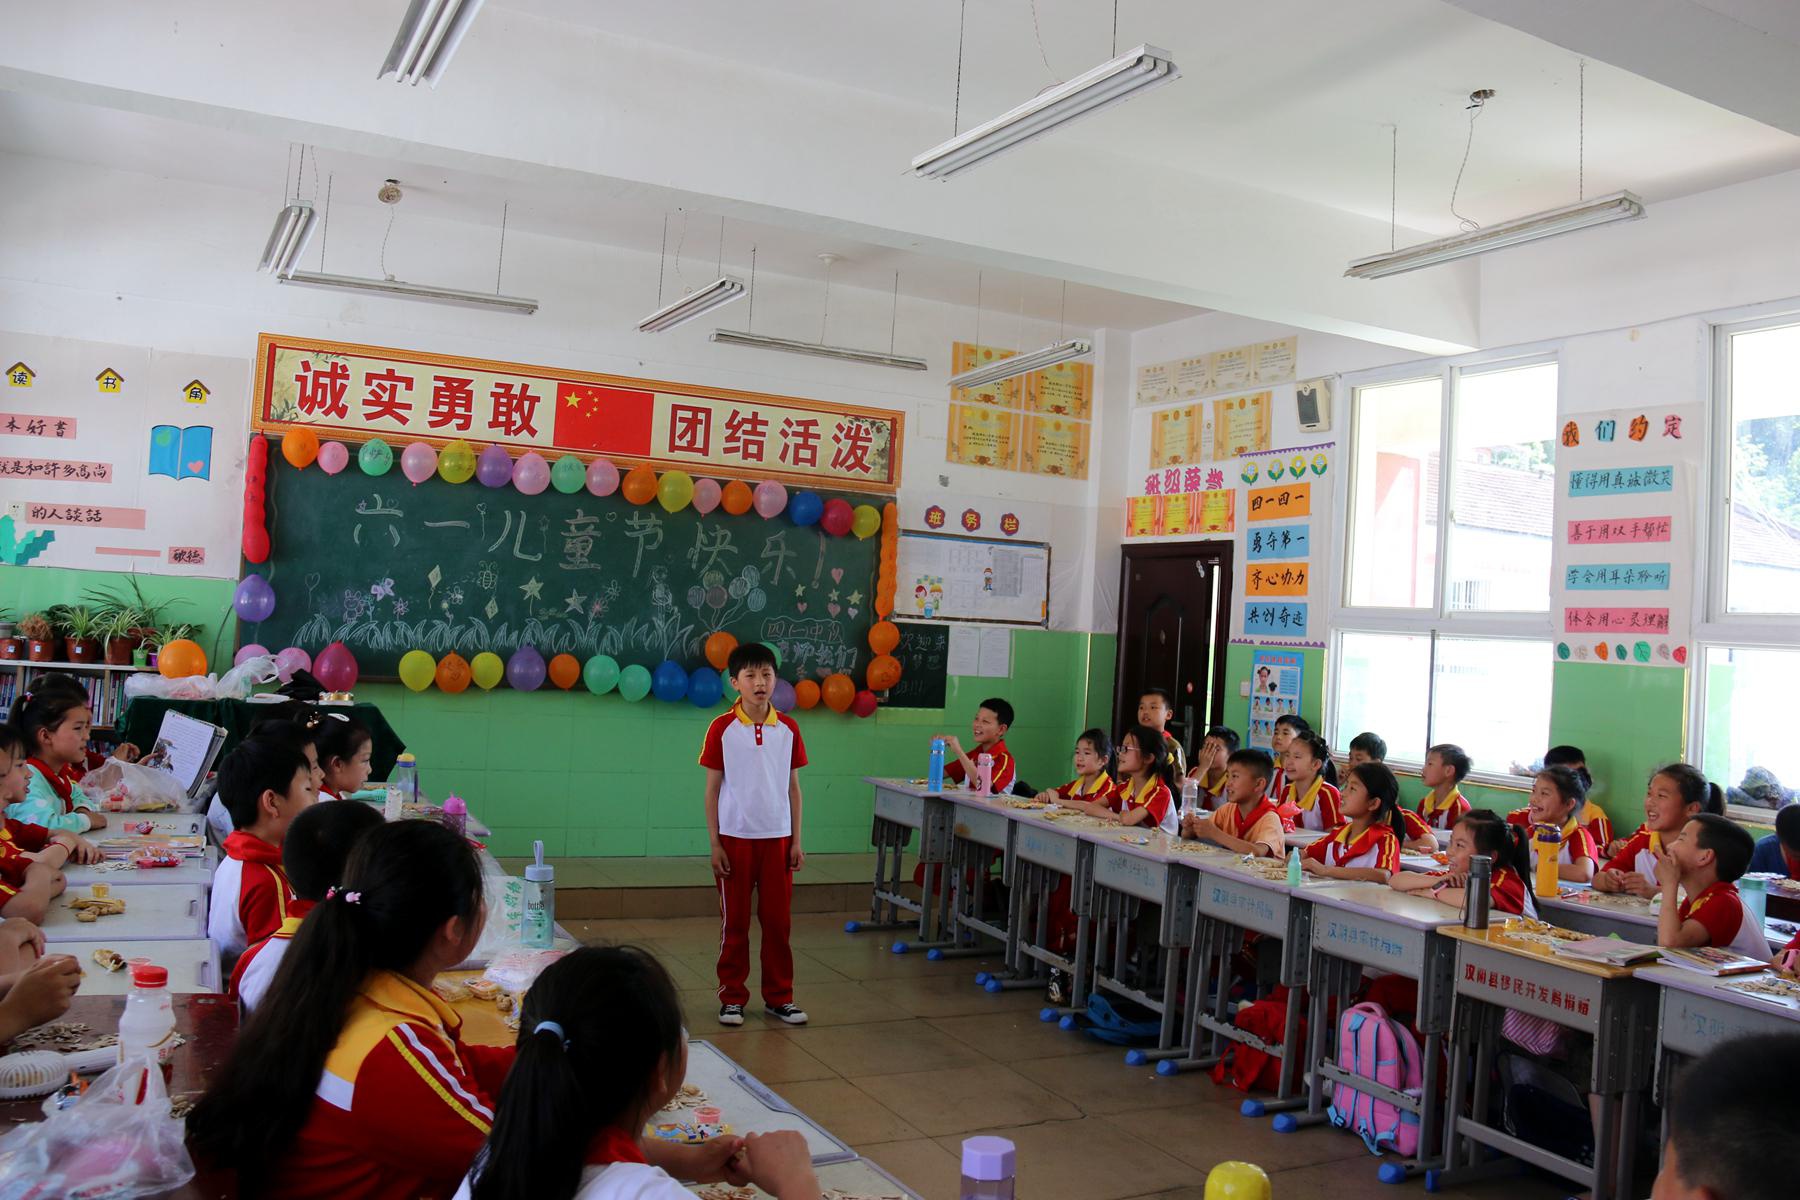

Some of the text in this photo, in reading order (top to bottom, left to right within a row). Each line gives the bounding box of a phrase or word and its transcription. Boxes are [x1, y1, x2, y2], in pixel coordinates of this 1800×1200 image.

[294, 360, 542, 438] 诚实勇敢
[668, 403, 875, 475] 团结活泼
[1562, 414, 1682, 447] 我们约定
[1252, 492, 1305, 511] 四一四一
[1252, 531, 1305, 552] 勇夺第一
[1251, 568, 1305, 590] 齐心协力
[1248, 606, 1304, 628] 共创奇迹
